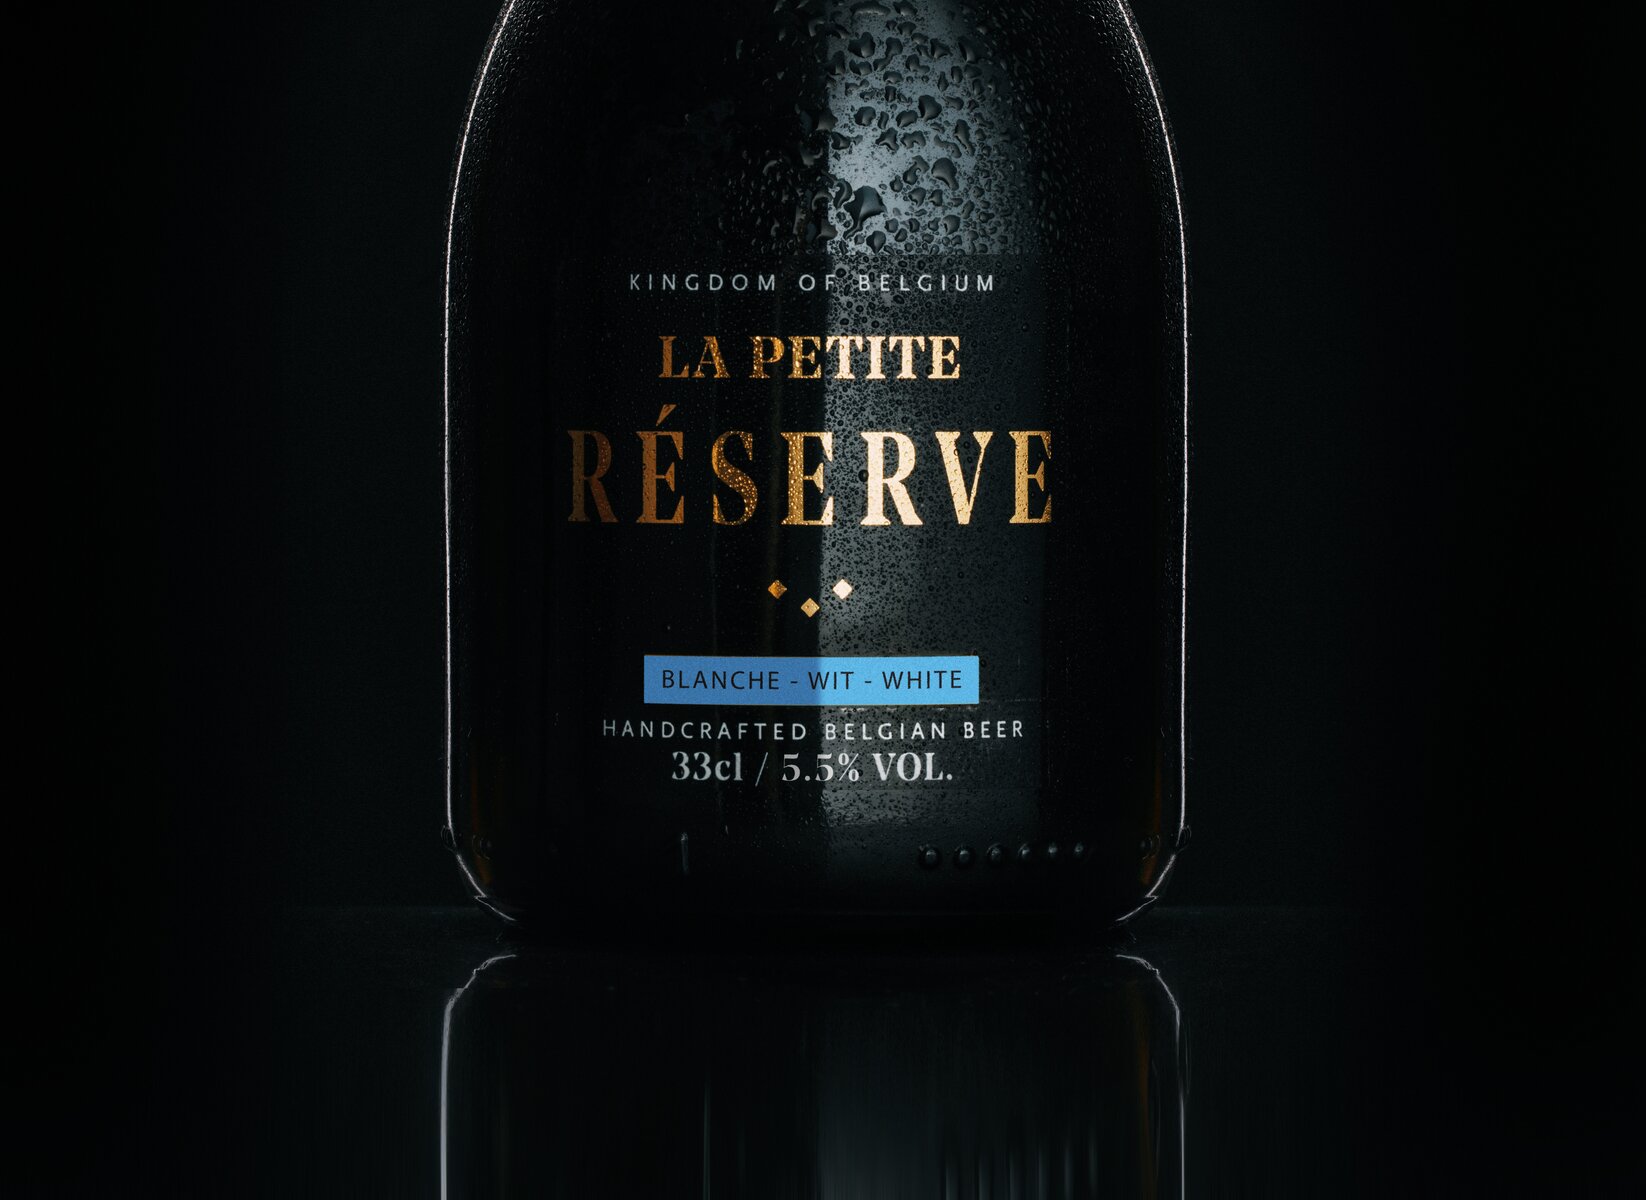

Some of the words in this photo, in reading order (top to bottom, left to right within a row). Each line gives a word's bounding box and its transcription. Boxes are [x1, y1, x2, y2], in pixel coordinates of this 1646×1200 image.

[630, 274, 776, 291] KINGDOM
[799, 274, 836, 291] OF
[859, 274, 995, 291] BELGIUM
[658, 336, 729, 379] LA
[749, 336, 961, 379] PETITE
[567, 404, 1052, 526] RÉSERVE
[662, 669, 780, 690] BLANCHE
[808, 671, 855, 690] WIT
[882, 670, 962, 689] WHITE
[603, 720, 807, 740] HANDCRAFTED
[825, 722, 946, 739] BELGIAN
[963, 721, 1024, 738] BEER
[671, 751, 743, 781] 33cl
[781, 752, 860, 782] 5.5%
[872, 751, 953, 781] VOL.
